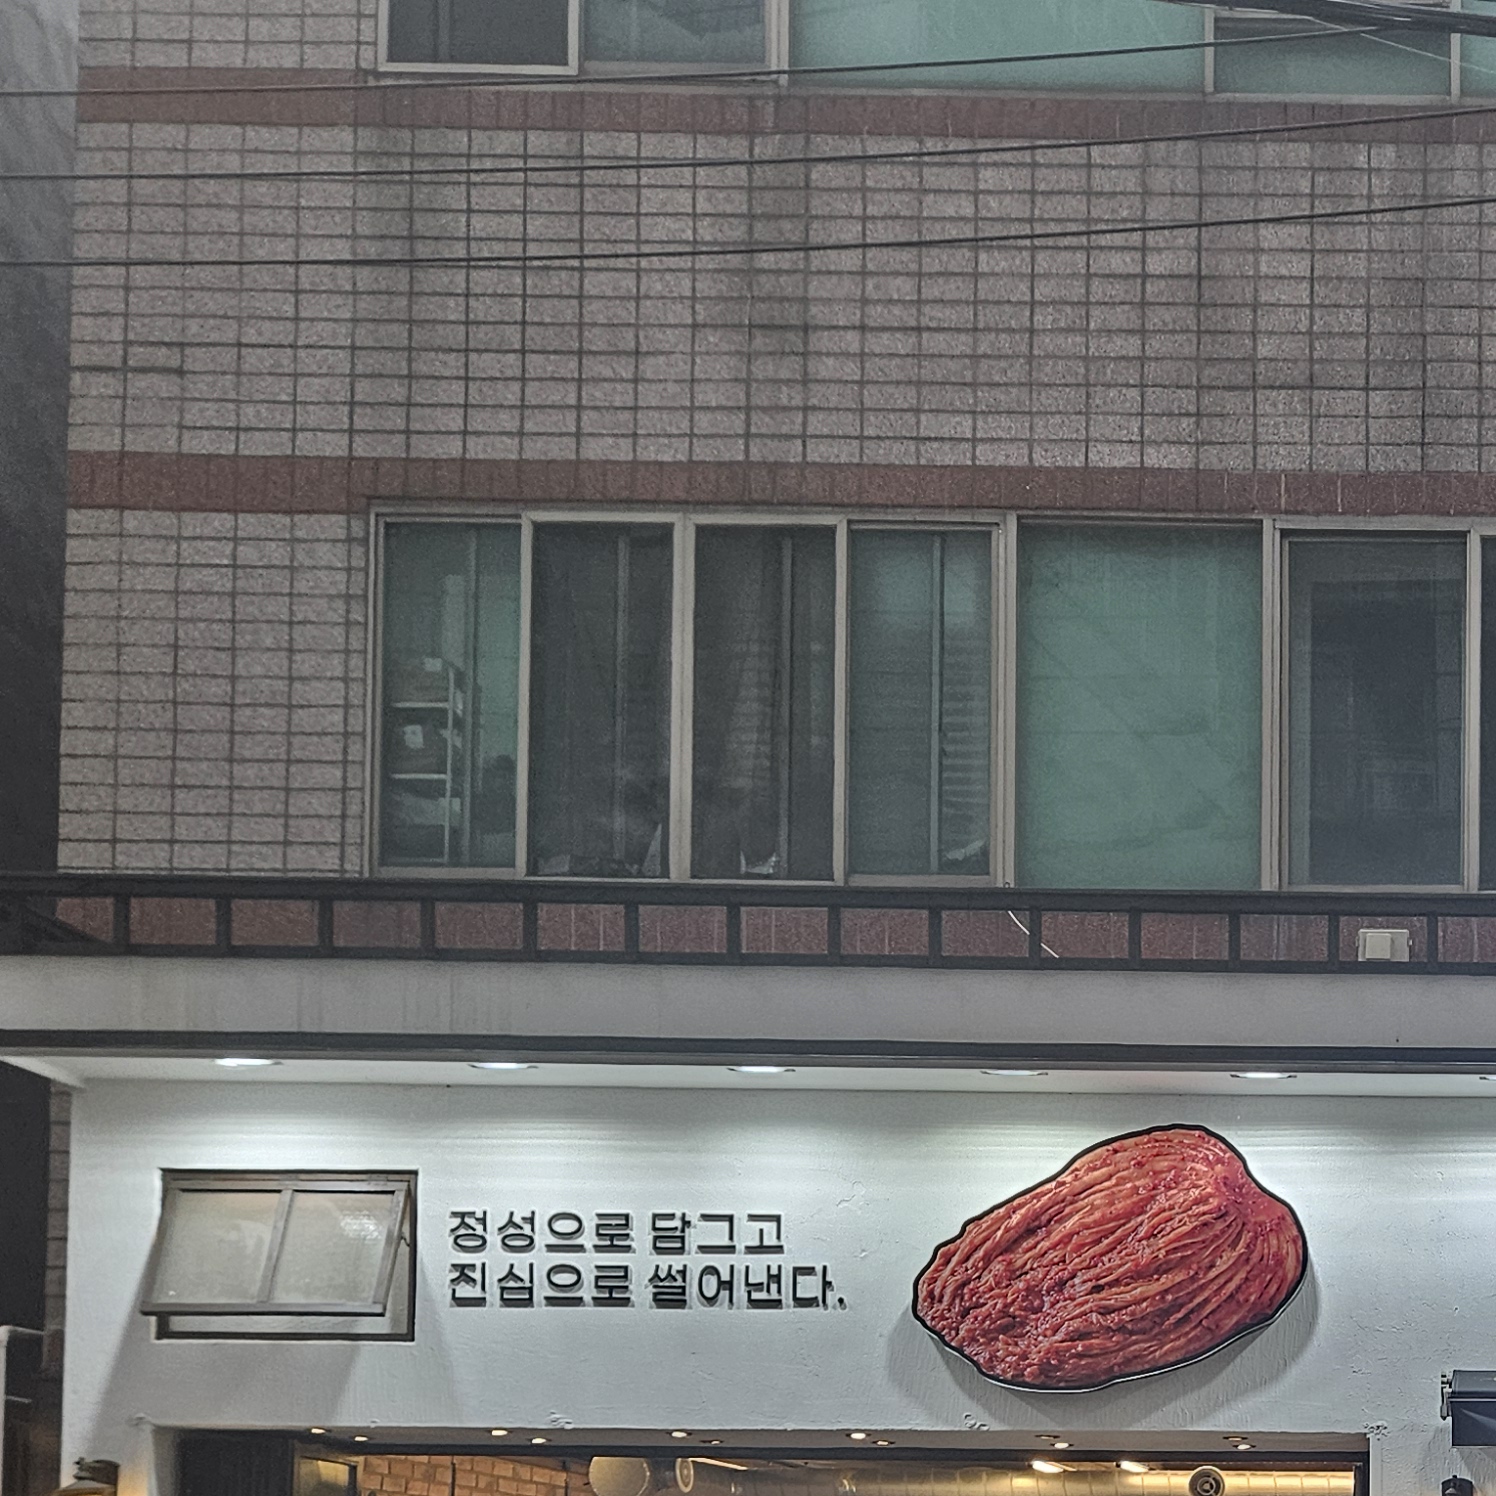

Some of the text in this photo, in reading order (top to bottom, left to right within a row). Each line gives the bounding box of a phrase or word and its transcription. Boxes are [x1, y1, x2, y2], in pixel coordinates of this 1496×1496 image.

[449, 1210, 785, 1255] 정성으로 담그고
[449, 1262, 848, 1310] 진심으로 썰어낸다.
